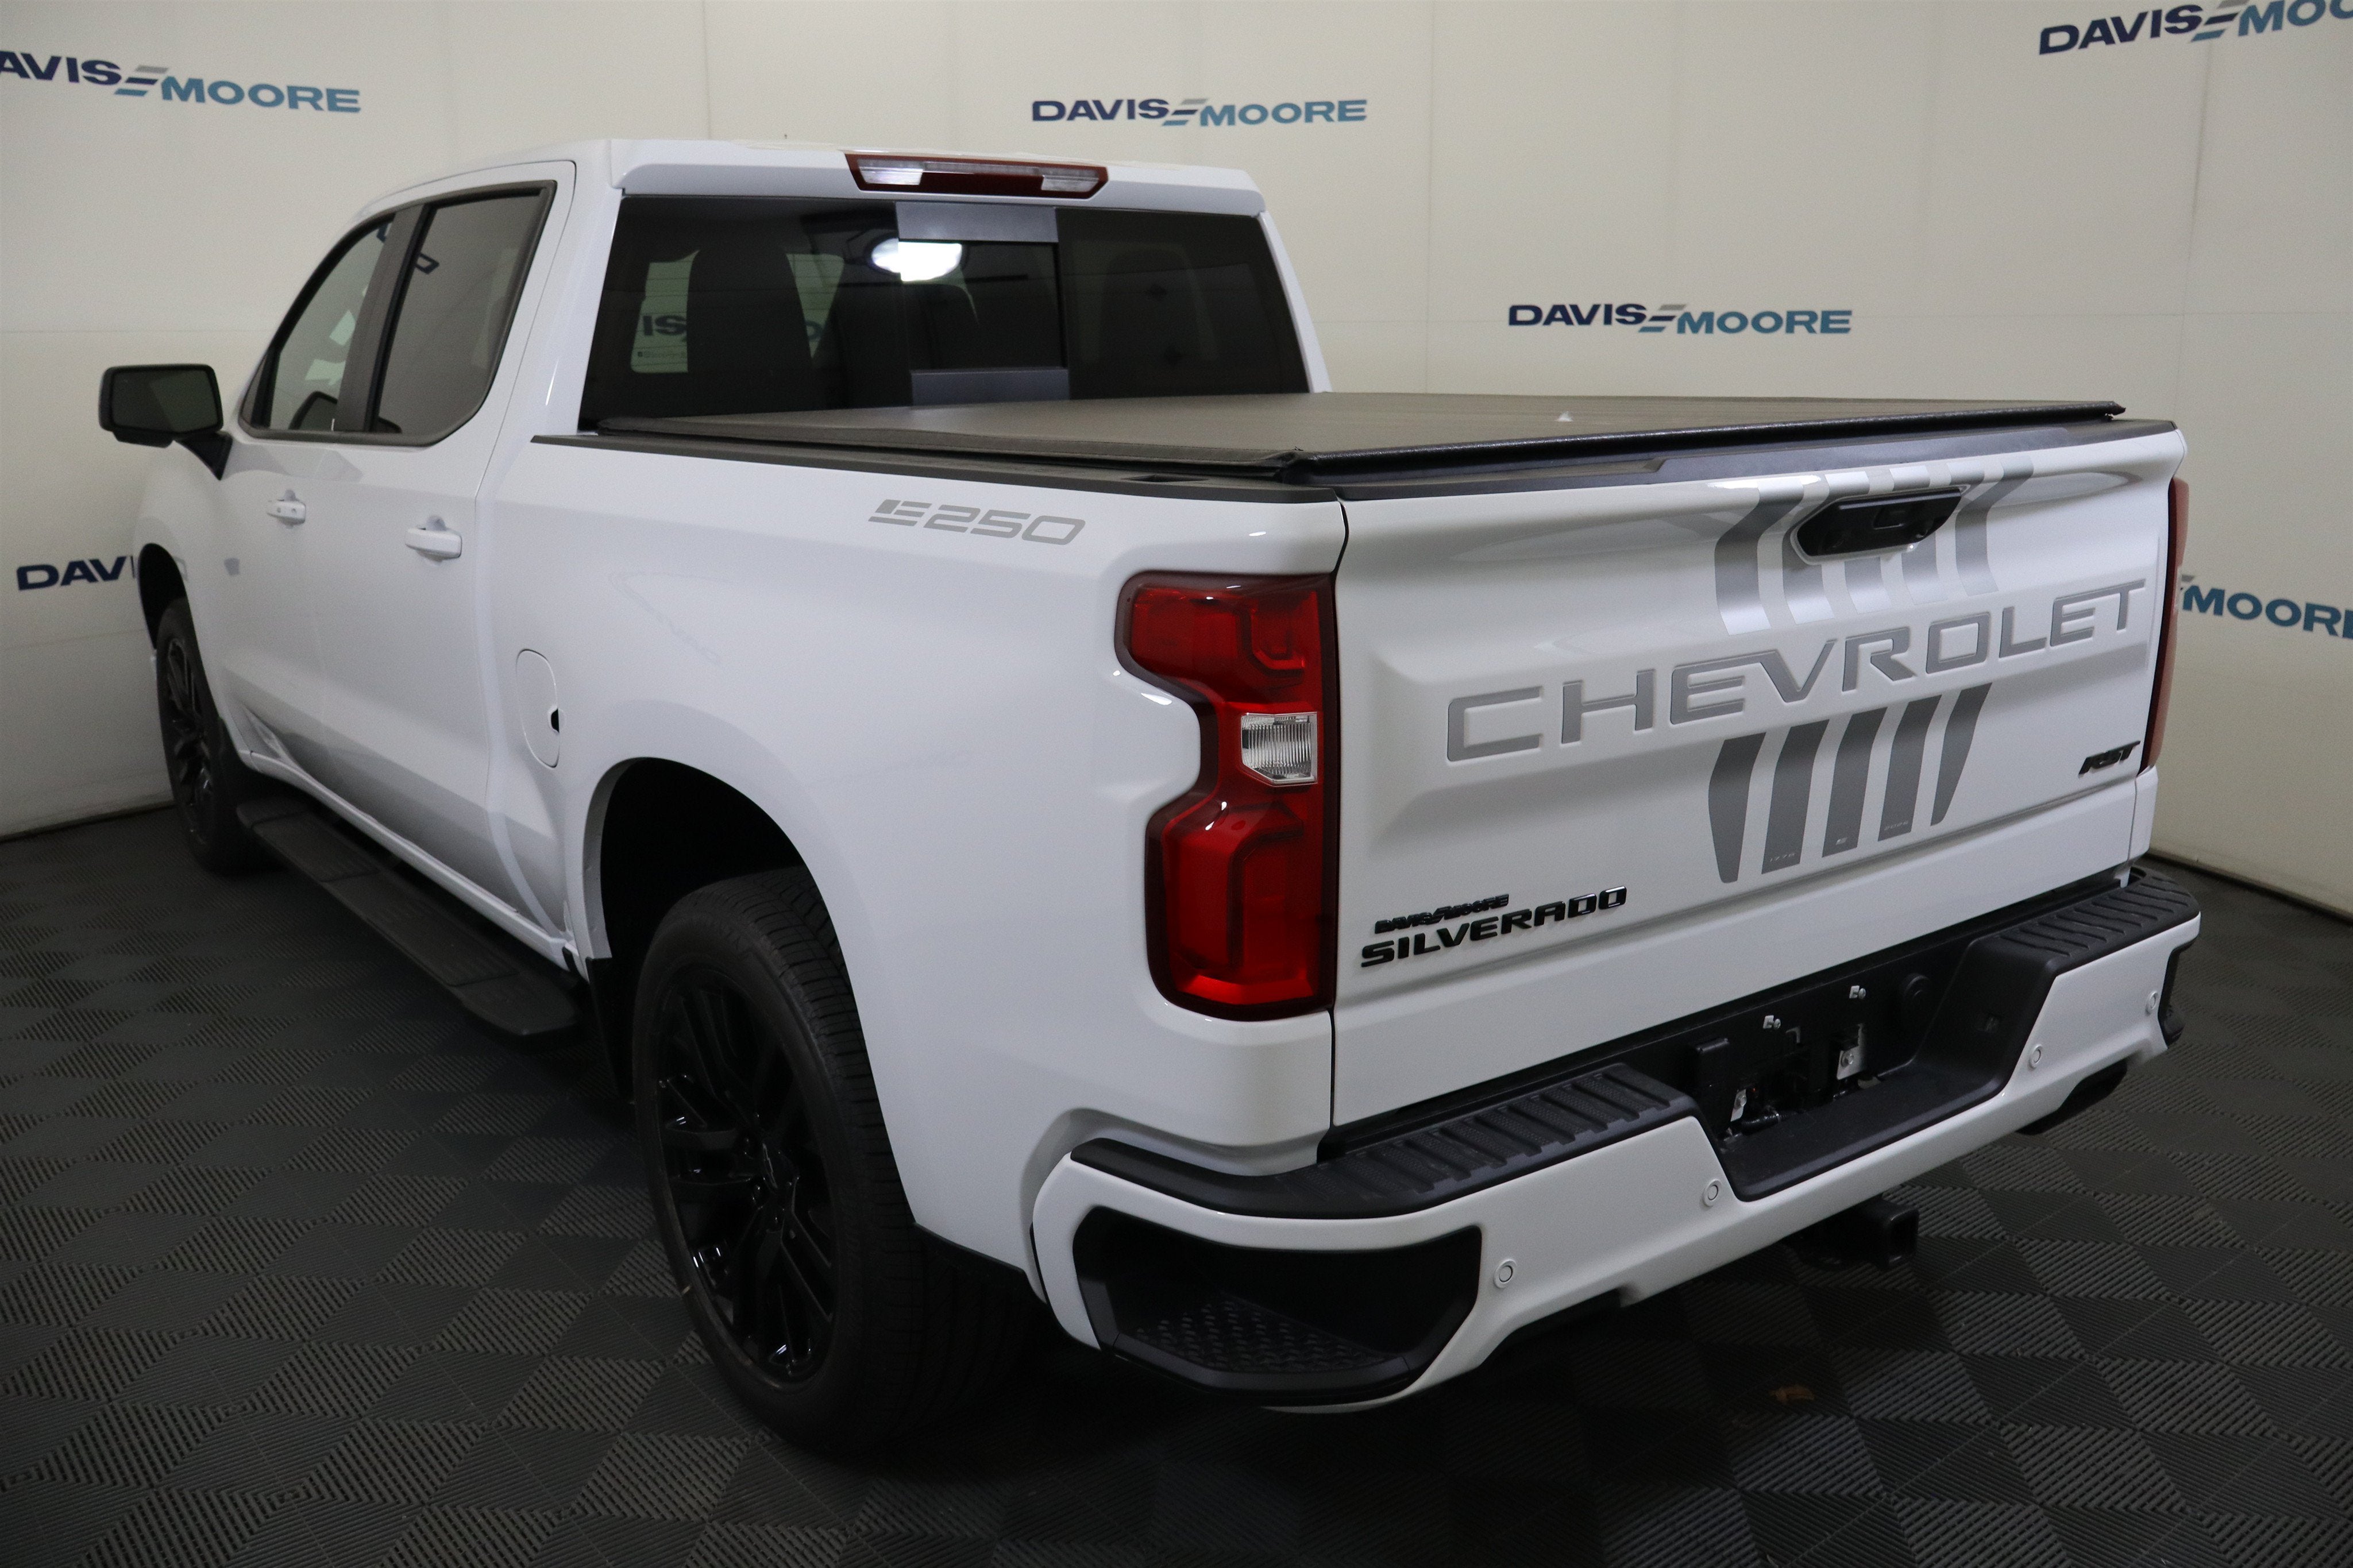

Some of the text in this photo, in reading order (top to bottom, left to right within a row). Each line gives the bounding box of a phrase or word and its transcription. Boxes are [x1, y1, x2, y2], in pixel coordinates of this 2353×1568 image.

[2039, 5, 2203, 55] DAVIS
[161, 76, 361, 113] MOORE
[1032, 99, 1367, 126] DAVIS MOORE
[1508, 303, 1853, 334] DAVIS MOORE
[16, 555, 135, 590] DAV
[1446, 578, 2146, 762] CHEVROLET
[2078, 740, 2142, 775] RST
[1361, 886, 1627, 967] SILVERADO
